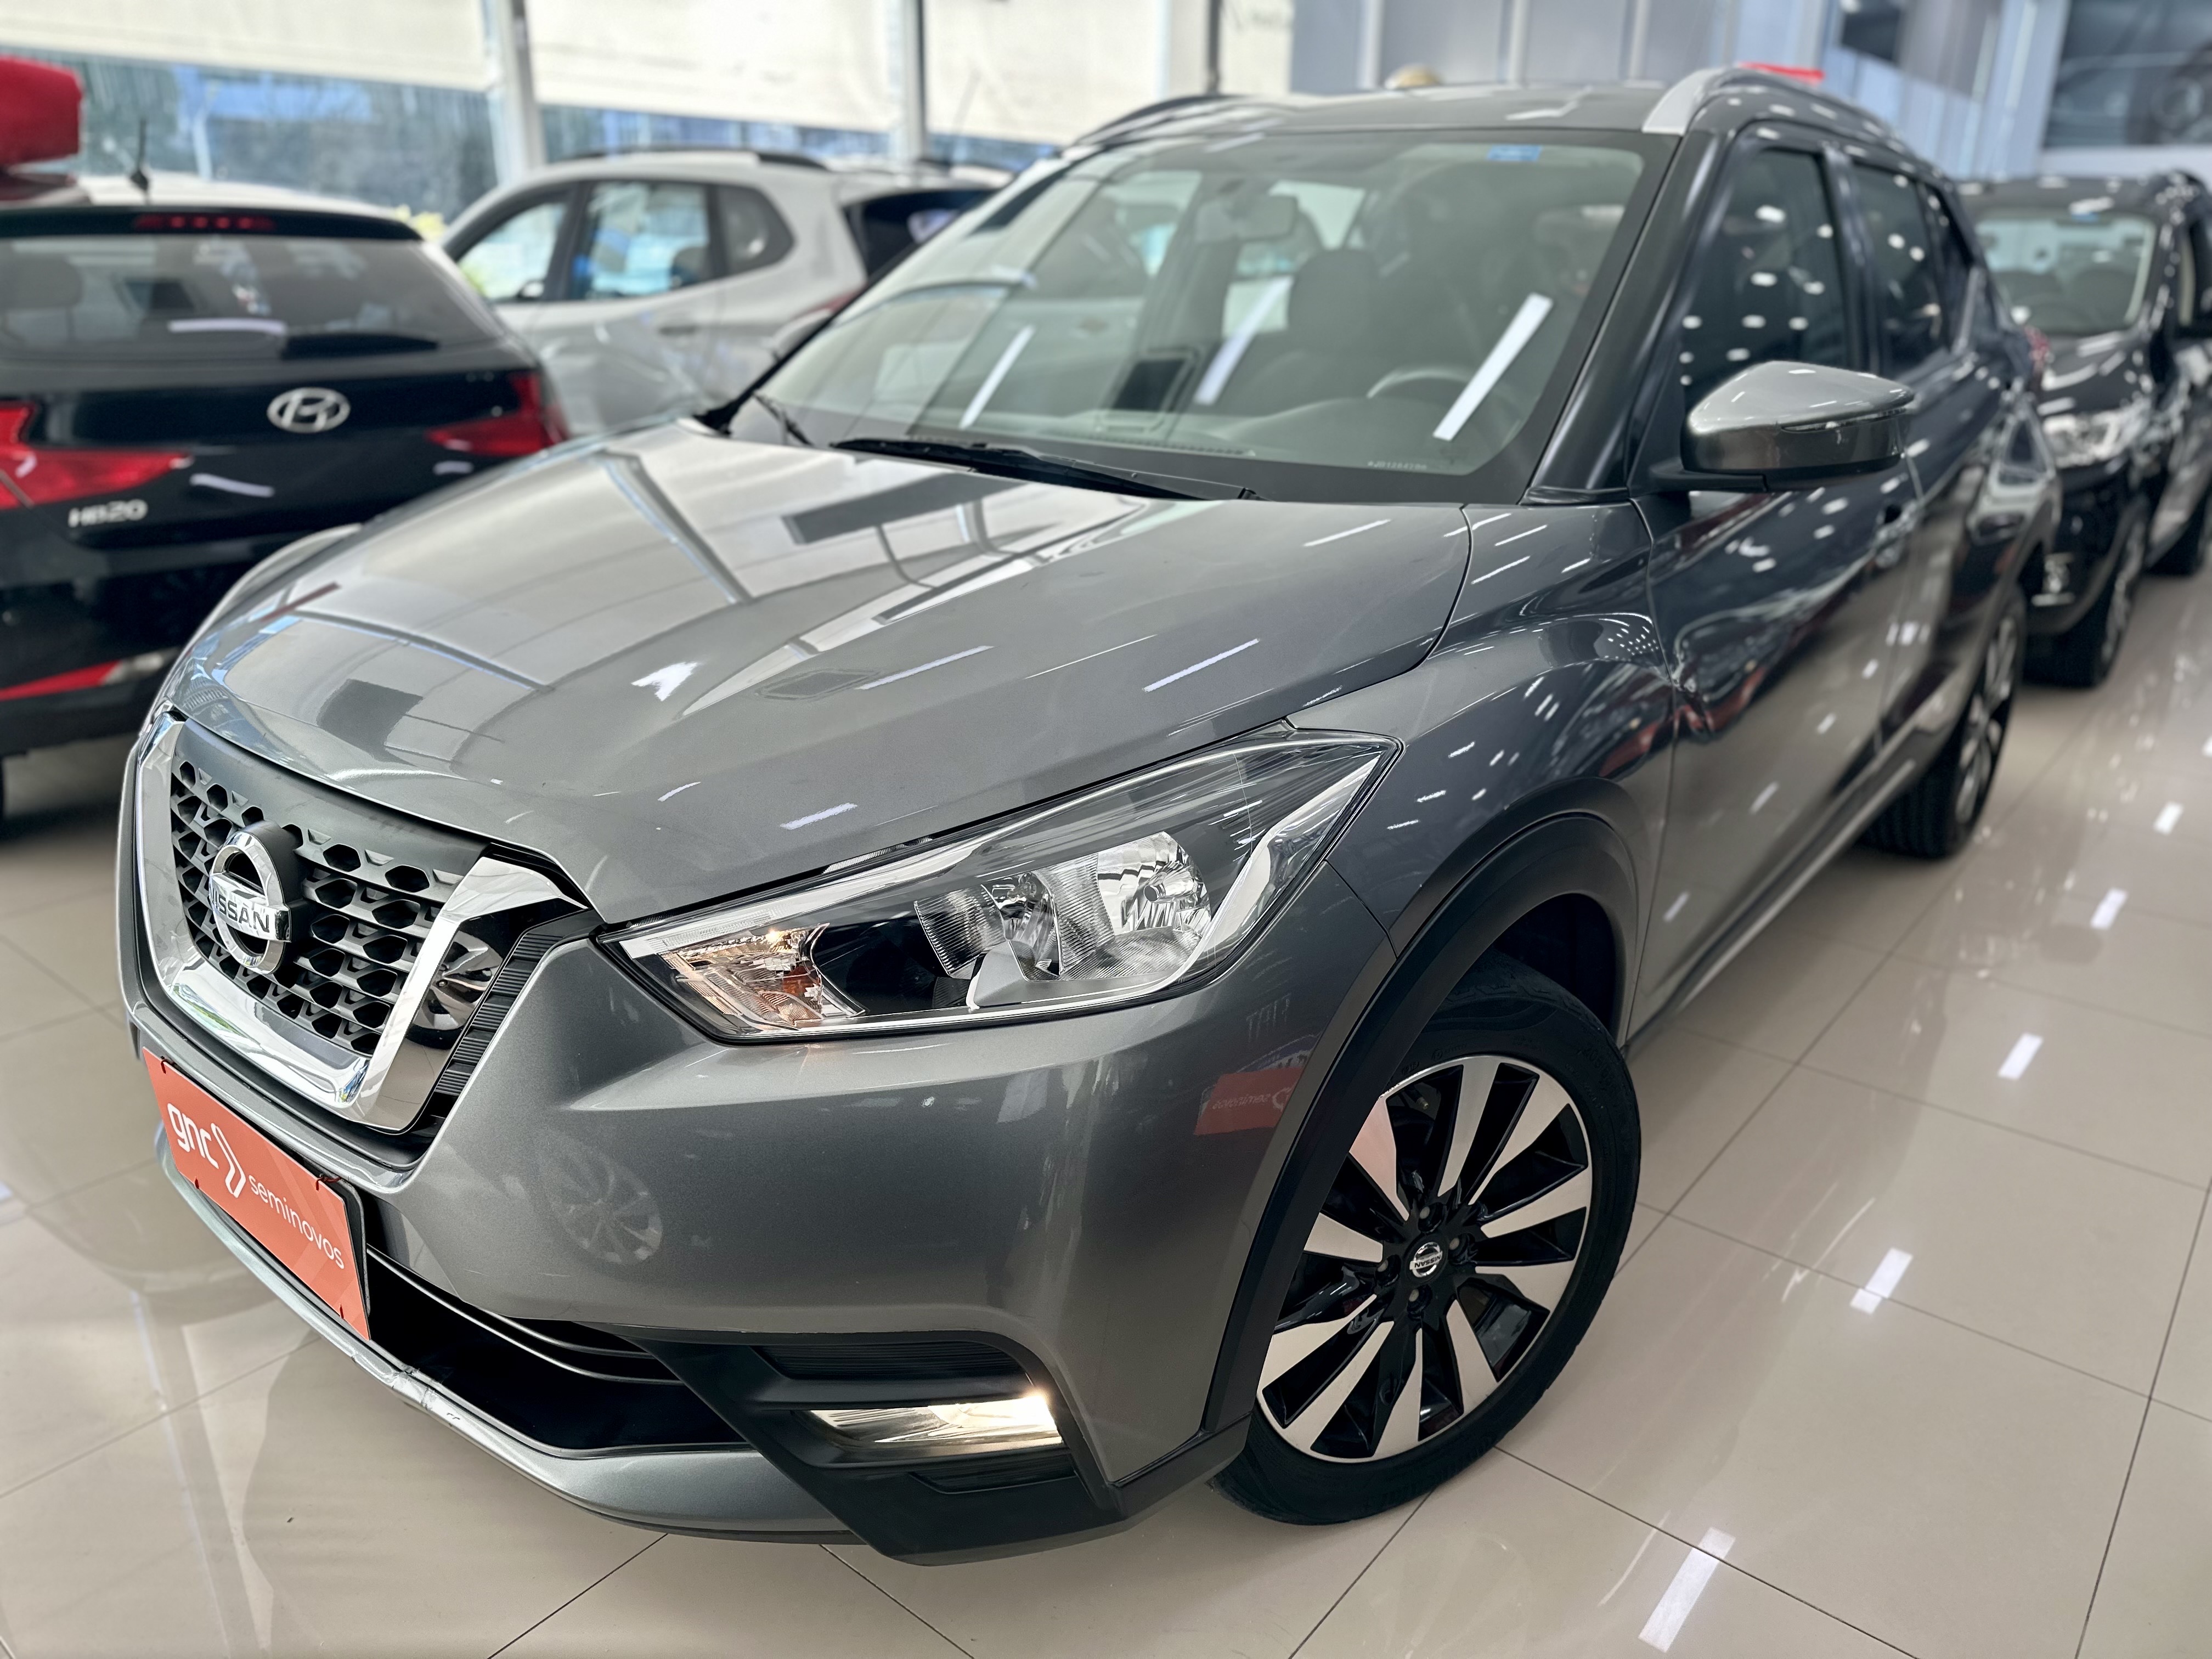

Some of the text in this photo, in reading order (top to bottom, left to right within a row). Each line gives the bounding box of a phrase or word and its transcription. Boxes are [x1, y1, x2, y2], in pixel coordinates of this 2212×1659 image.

[67, 498, 149, 528] HB20
[208, 882, 270, 933] NISSAN
[167, 1103, 345, 1269] gnc seminovos
[1414, 1254, 1442, 1268] NISSAN
